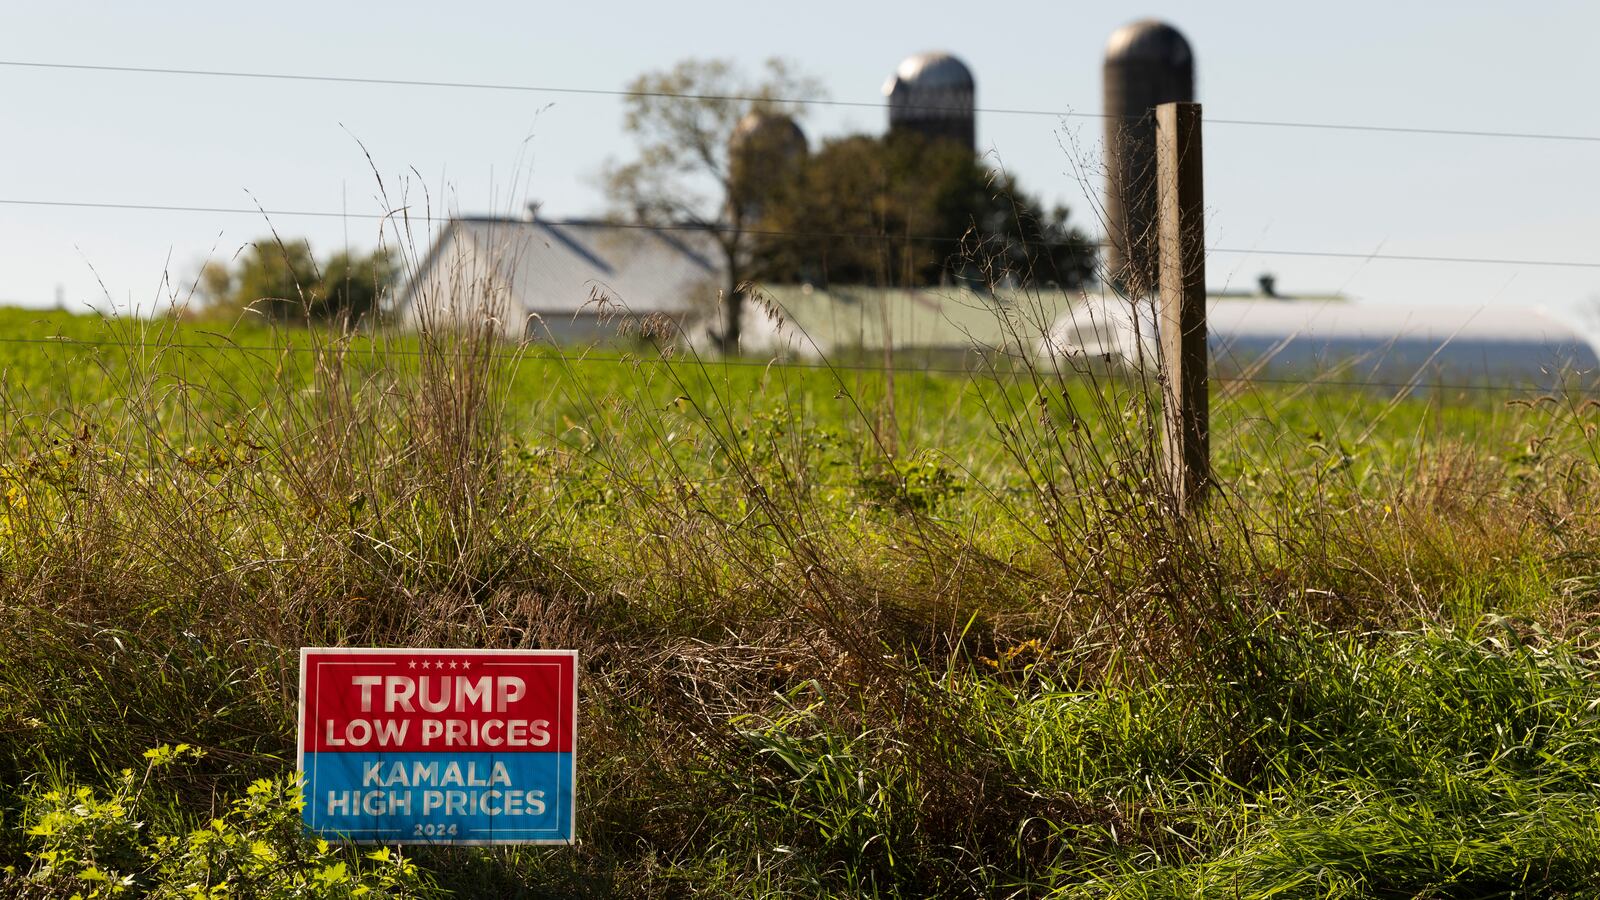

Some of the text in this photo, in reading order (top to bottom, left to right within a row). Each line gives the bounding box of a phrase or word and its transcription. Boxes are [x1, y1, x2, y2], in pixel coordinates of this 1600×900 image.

[351, 675, 527, 713] TRUMP
[325, 719, 551, 747] LOW PRICES
[362, 760, 512, 787] KAMALA
[327, 790, 546, 816] HIGH PRICES
[413, 823, 458, 836] 2024
